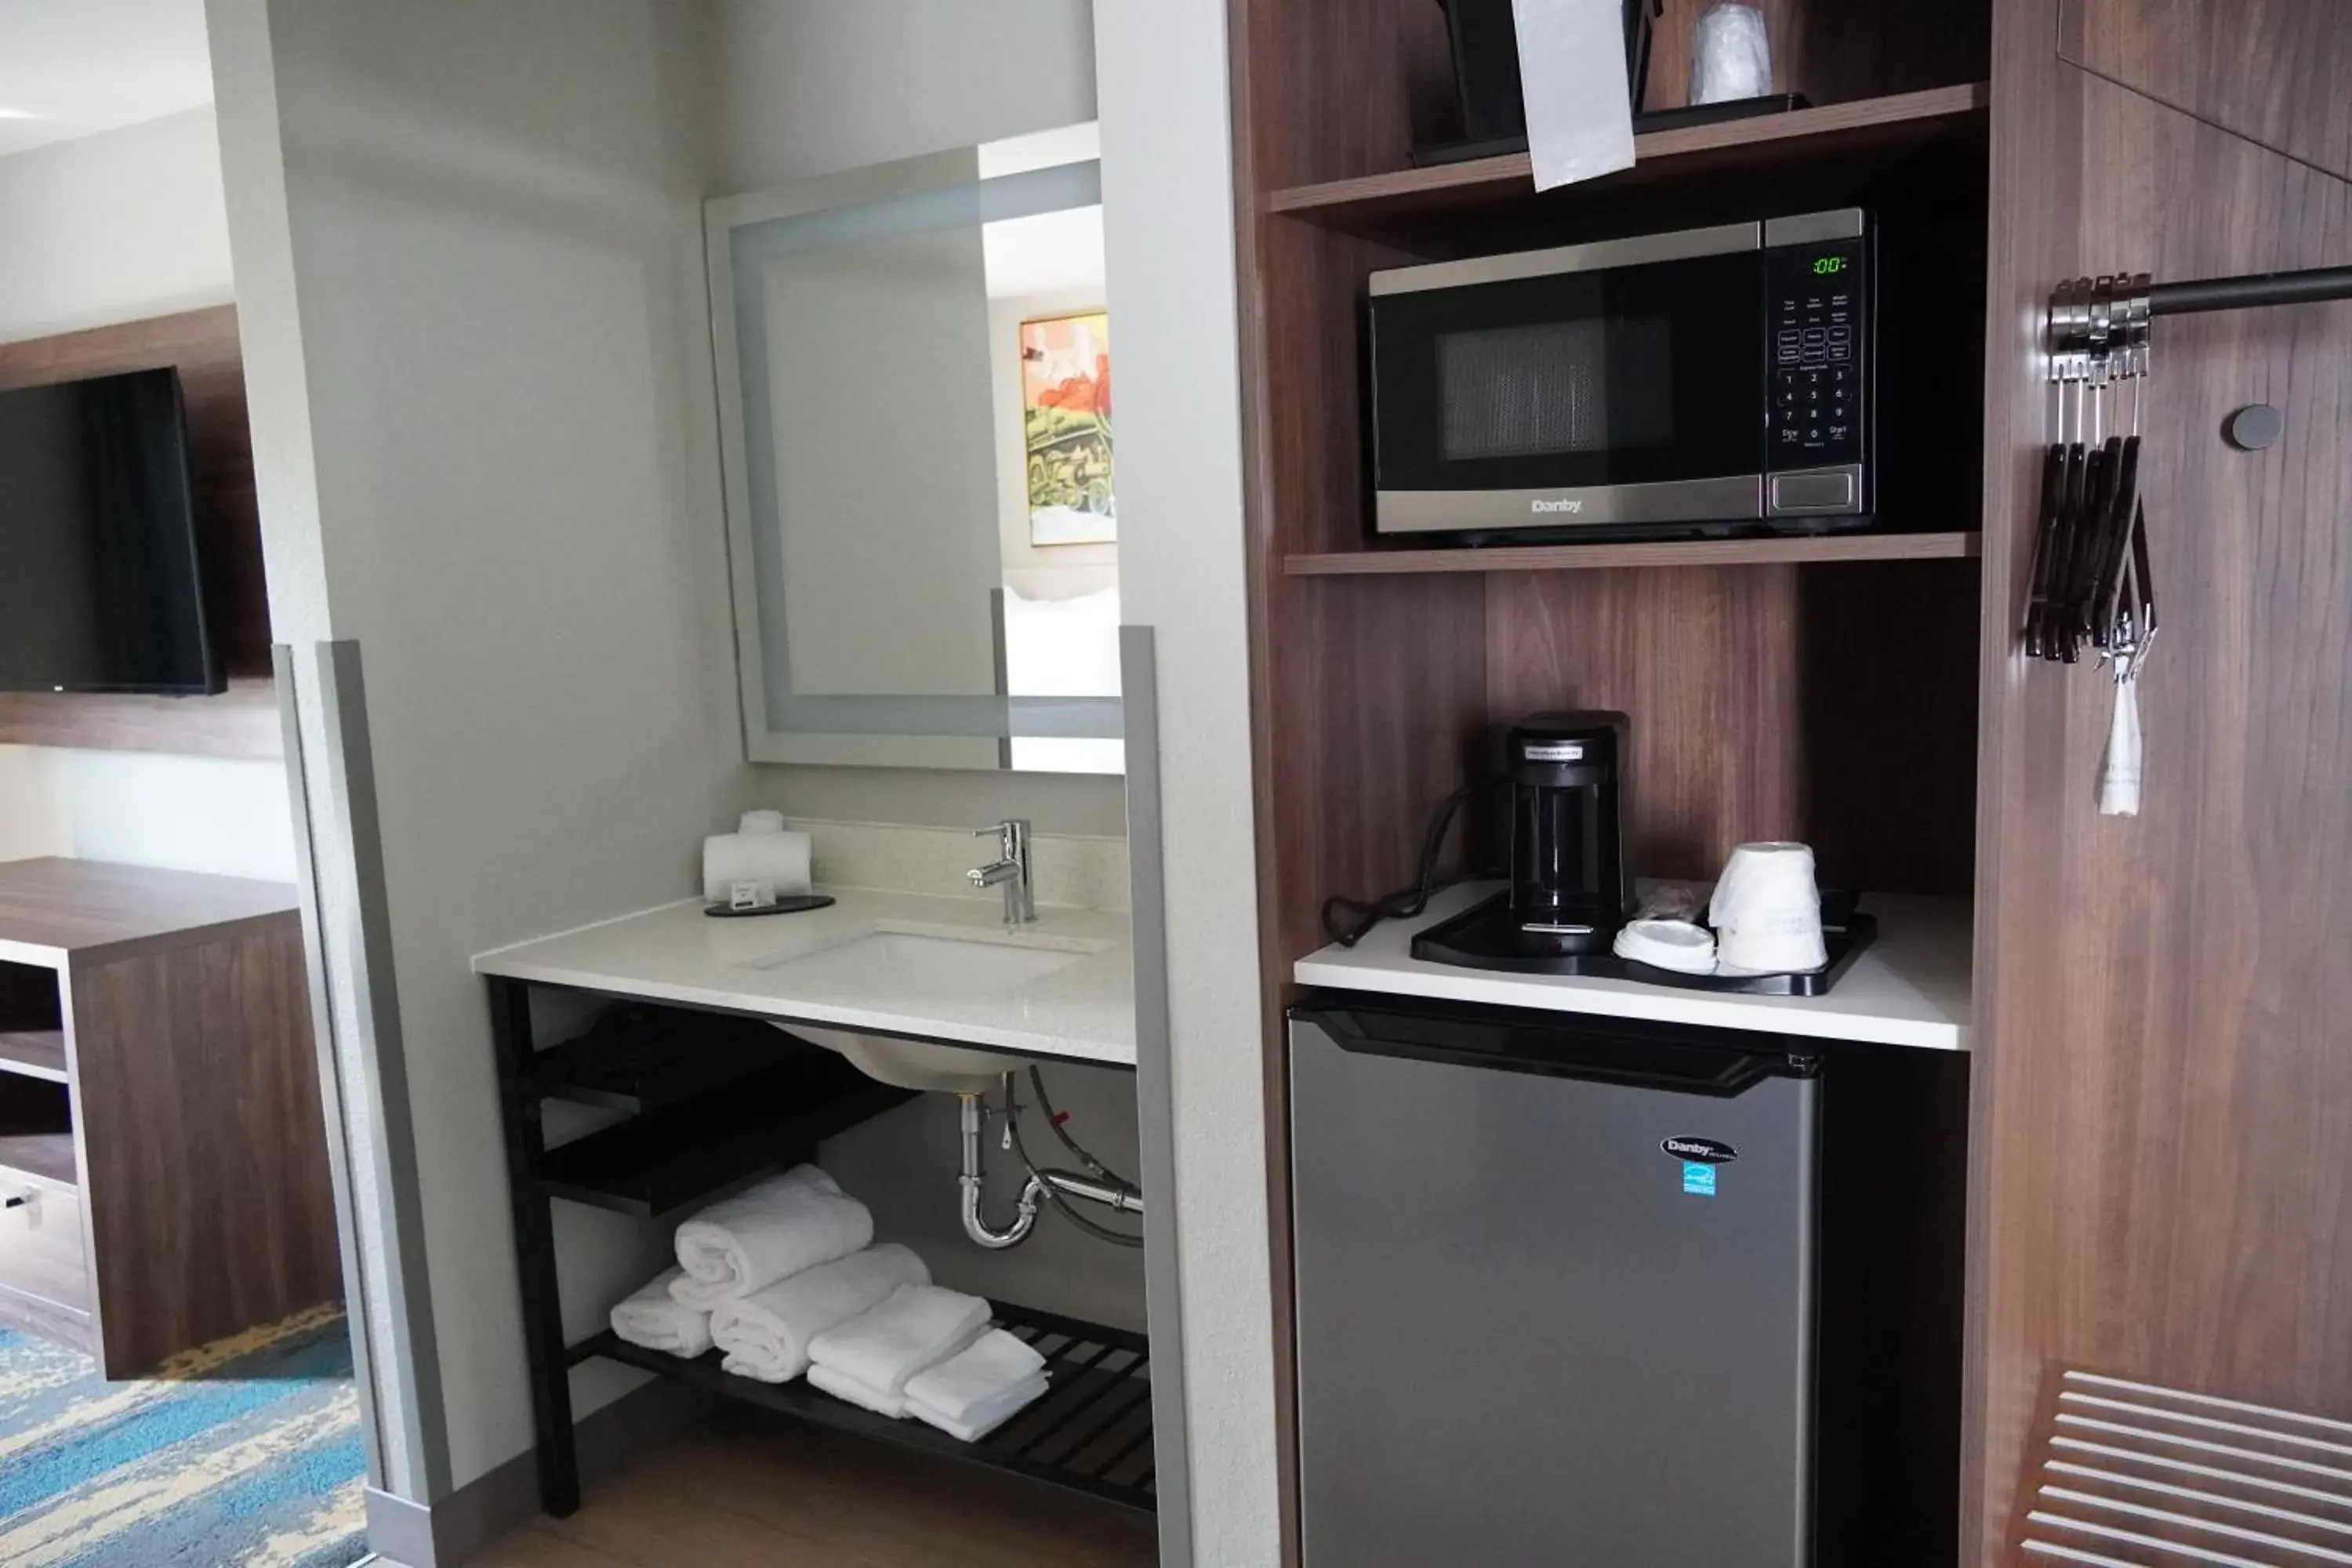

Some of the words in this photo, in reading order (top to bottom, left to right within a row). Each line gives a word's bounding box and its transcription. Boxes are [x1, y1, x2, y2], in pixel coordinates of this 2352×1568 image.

[1811, 373, 1817, 382] 2
[1787, 411, 1793, 420] 7
[1810, 409, 1817, 418] 8
[1810, 430, 1818, 438] 0
[1531, 499, 1581, 514] Danby
[1668, 1140, 1710, 1156] Danby
